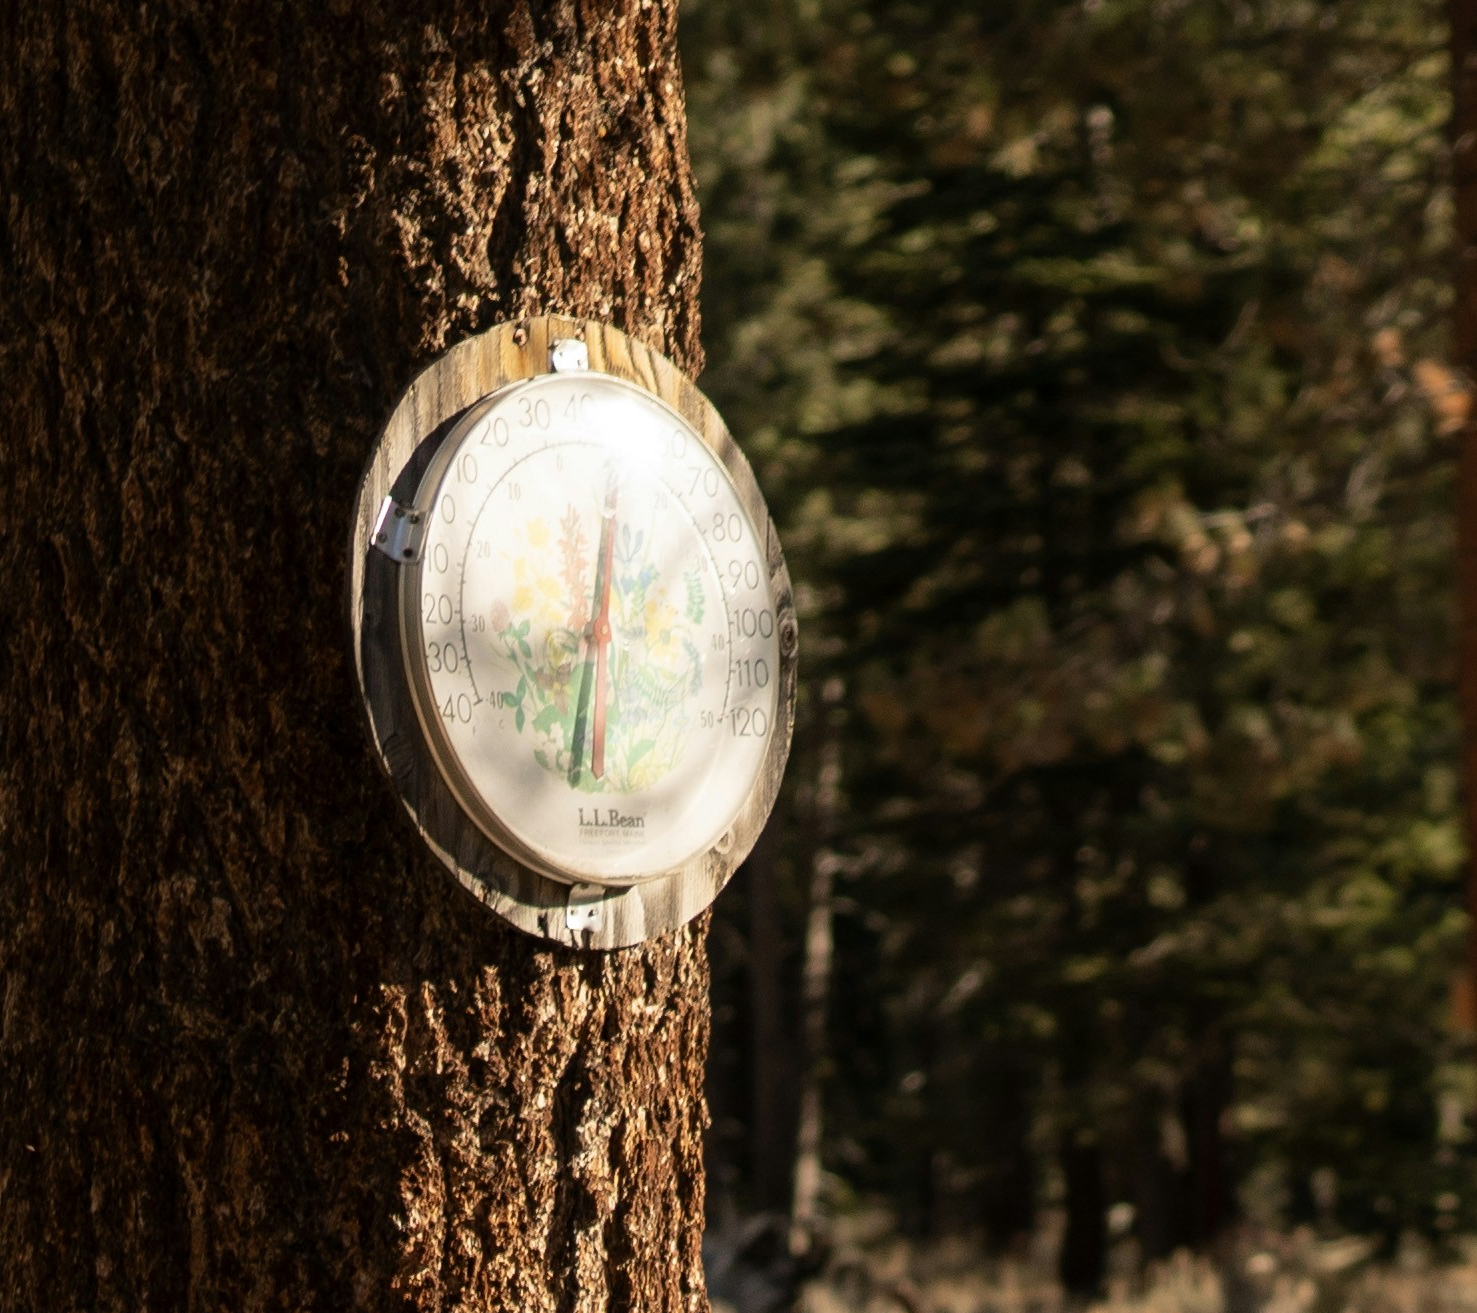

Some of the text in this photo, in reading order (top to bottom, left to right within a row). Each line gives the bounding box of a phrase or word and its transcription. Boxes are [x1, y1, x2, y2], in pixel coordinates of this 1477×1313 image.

[518, 397, 551, 430] 30
[480, 417, 509, 448] 20
[456, 453, 478, 484] 10
[688, 467, 719, 498] 70
[440, 493, 456, 525] 0
[712, 513, 742, 543] 80
[728, 559, 759, 591] 90
[735, 608, 773, 640] 100
[737, 657, 770, 688] 110
[730, 706, 768, 738] 120
